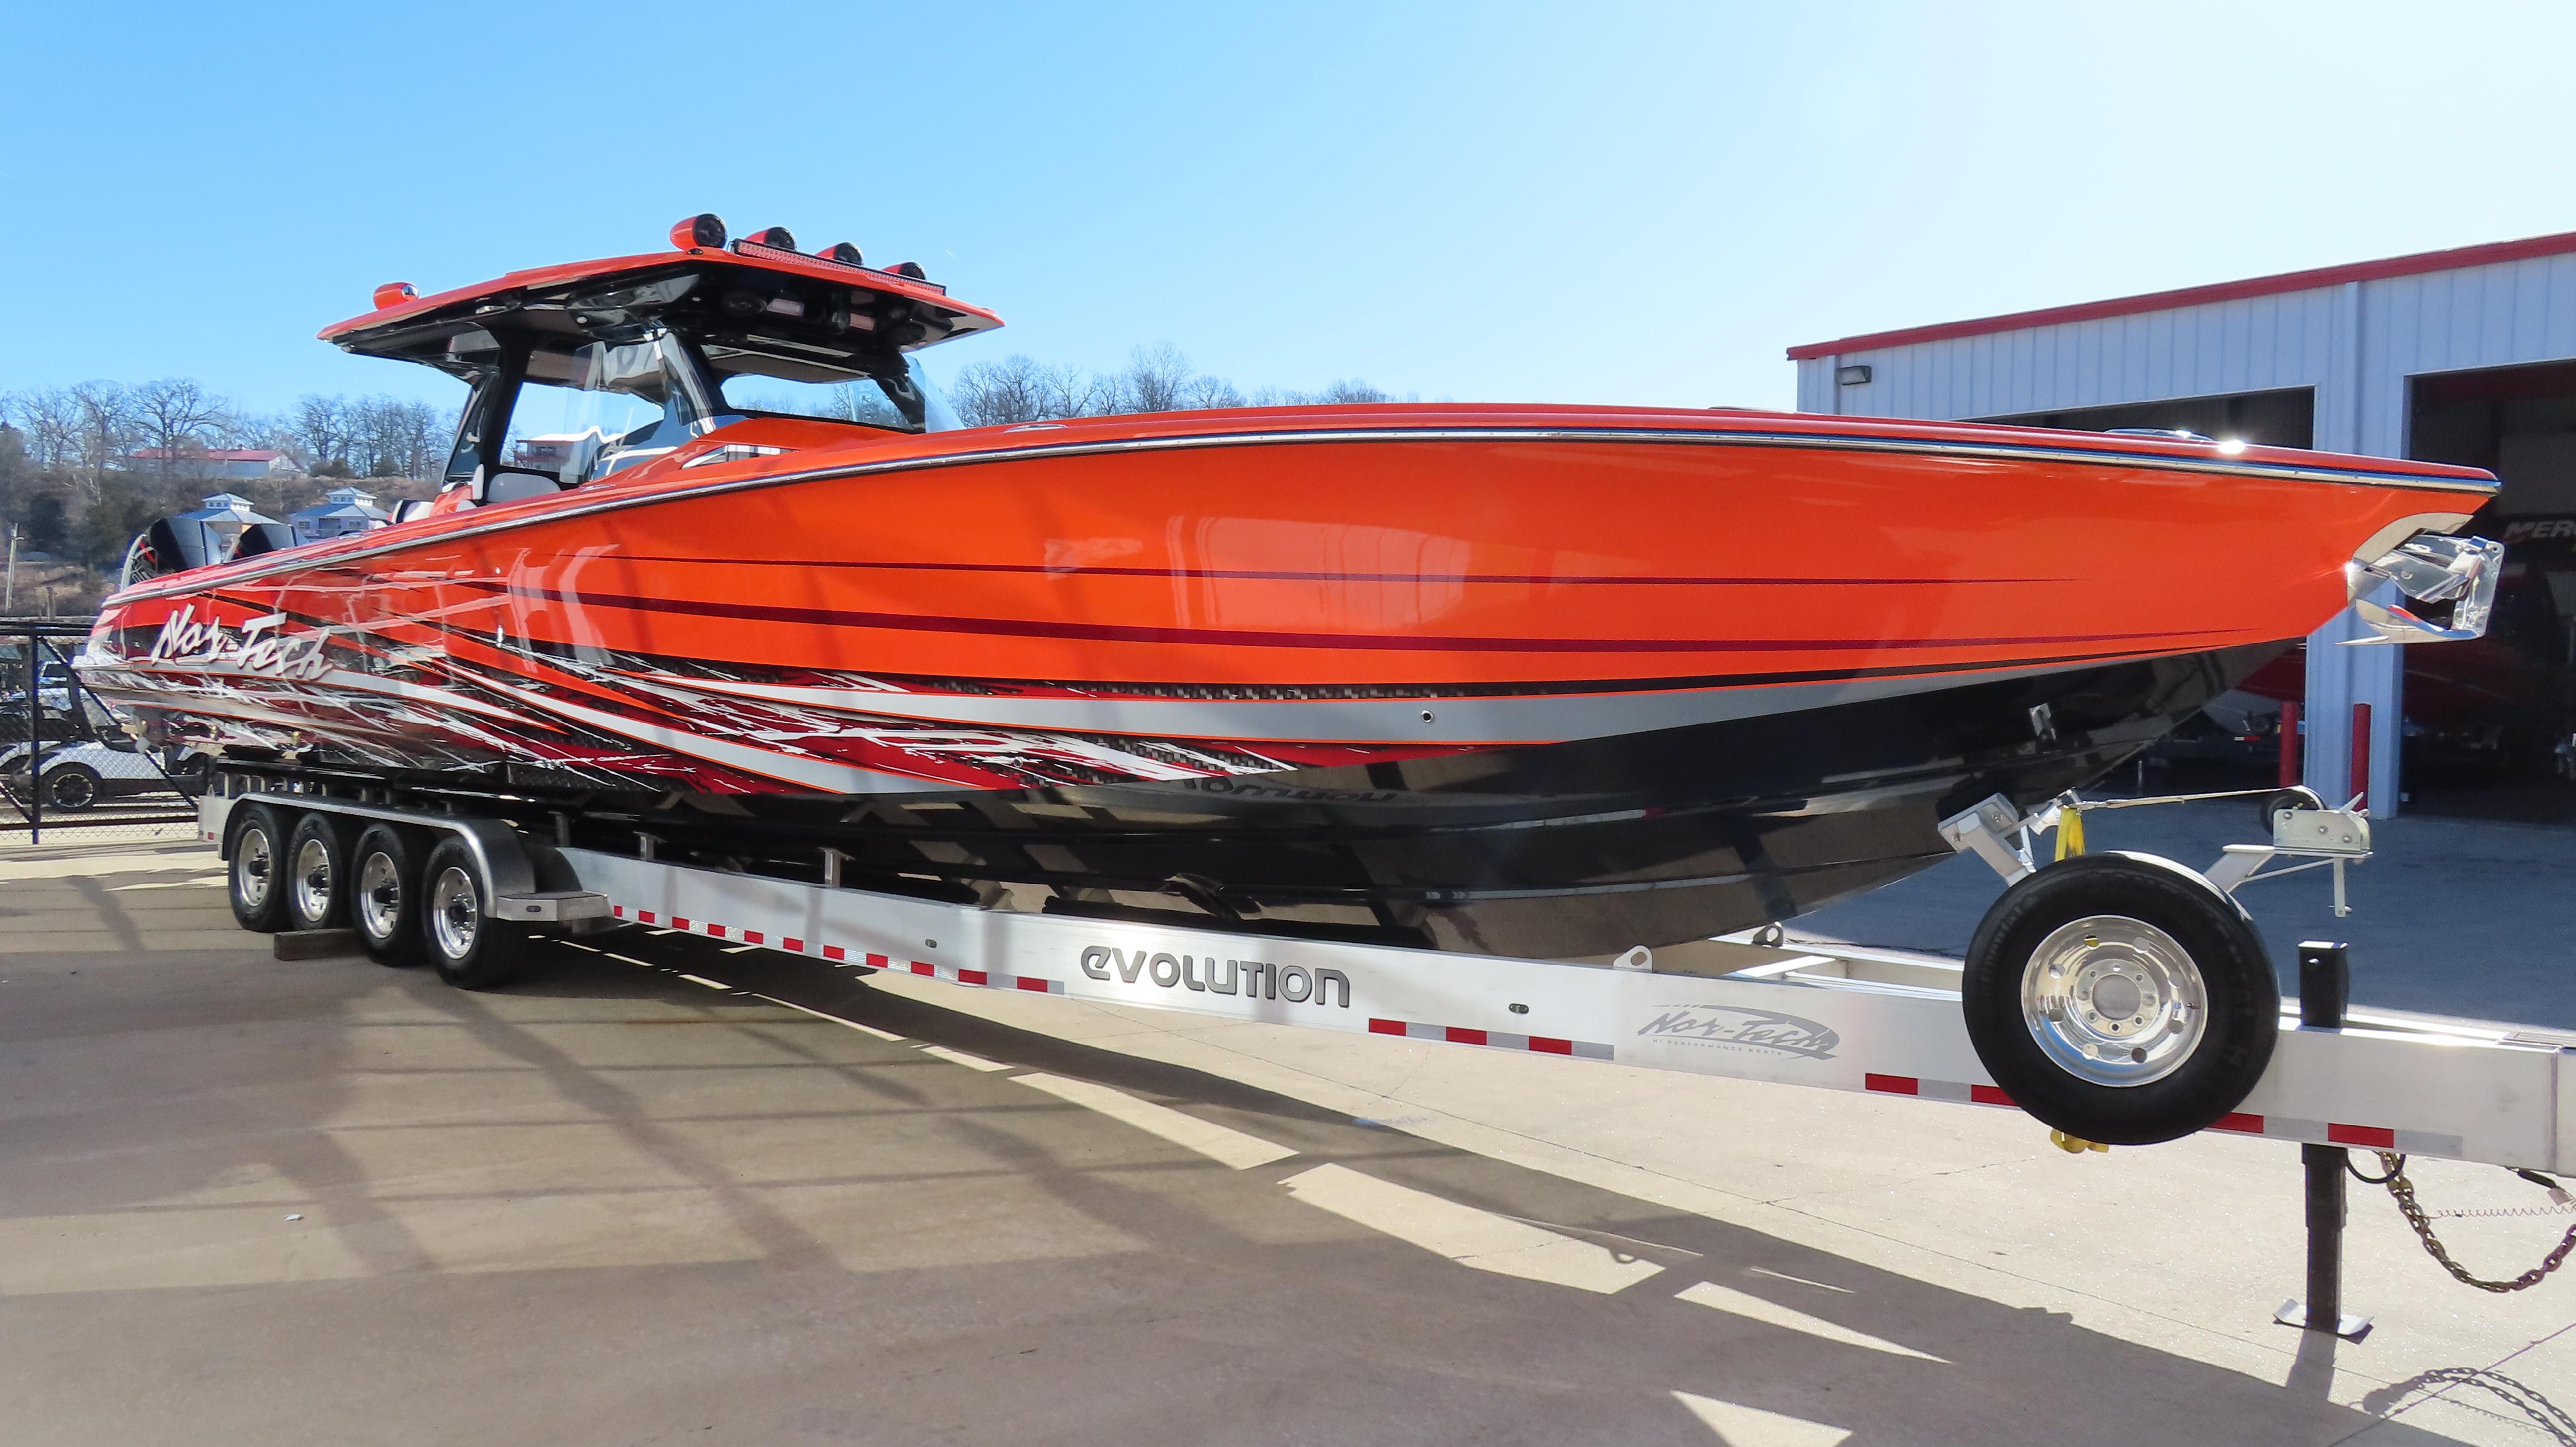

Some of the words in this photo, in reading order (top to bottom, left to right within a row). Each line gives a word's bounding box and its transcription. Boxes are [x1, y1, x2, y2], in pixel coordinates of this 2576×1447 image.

[2504, 521, 2576, 538] MER
[151, 603, 333, 681] Nor-Tech
[1637, 1011, 1835, 1051] Nor-Tech
[1668, 1040, 1742, 1052] PERFORMANCE
